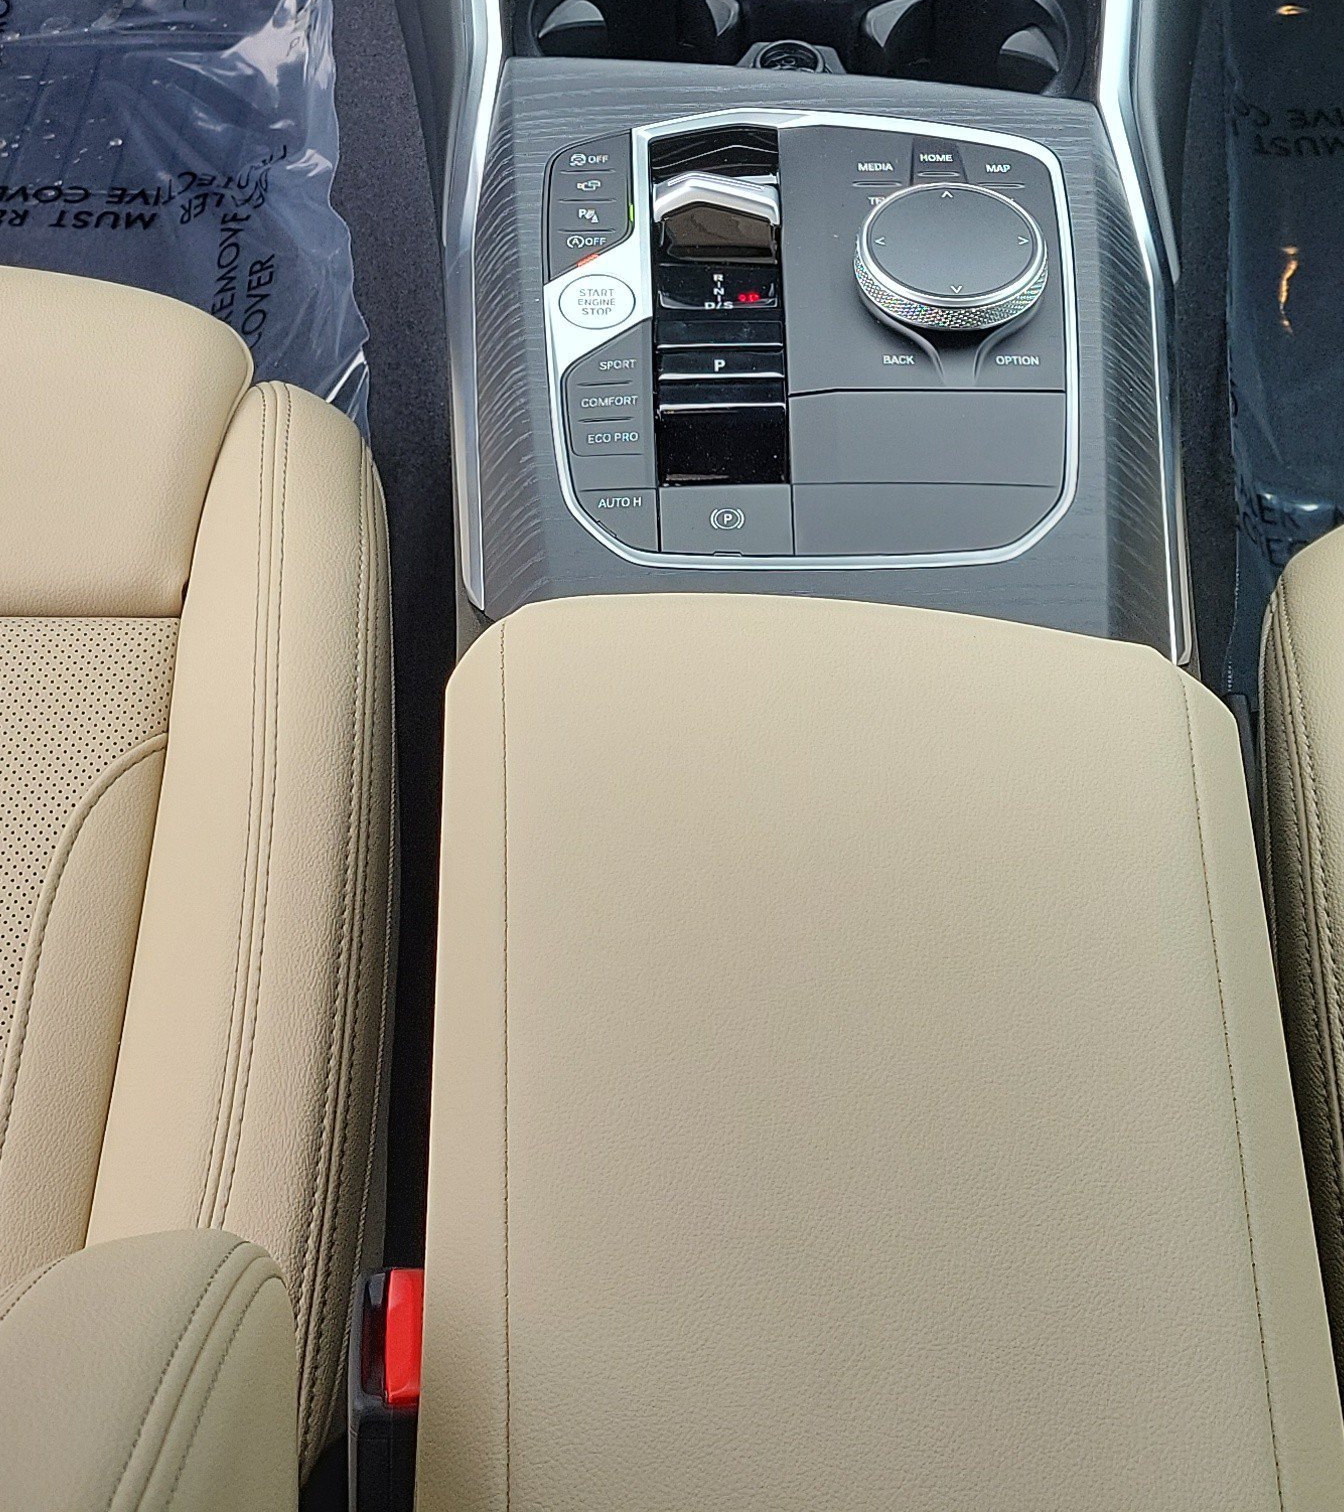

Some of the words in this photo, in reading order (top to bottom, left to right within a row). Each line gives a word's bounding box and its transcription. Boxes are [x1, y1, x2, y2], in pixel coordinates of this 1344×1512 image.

[588, 154, 608, 164] OFF
[920, 154, 954, 162] HOME
[858, 162, 894, 172] MEDIA
[985, 164, 1011, 173] MAP
[46, 209, 157, 230] MUST
[584, 237, 606, 246] OFF
[579, 288, 614, 298] START
[577, 298, 616, 307] ENGINE
[582, 307, 612, 316] STOP
[599, 360, 636, 371] SPORT
[713, 359, 726, 372] P
[883, 355, 916, 366] BACK
[996, 355, 1040, 366] OPTION
[581, 396, 638, 408] COMFORT
[588, 434, 612, 444] ECO
[614, 432, 638, 442] PRO
[598, 498, 630, 508] AUTO
[633, 496, 642, 507] H
